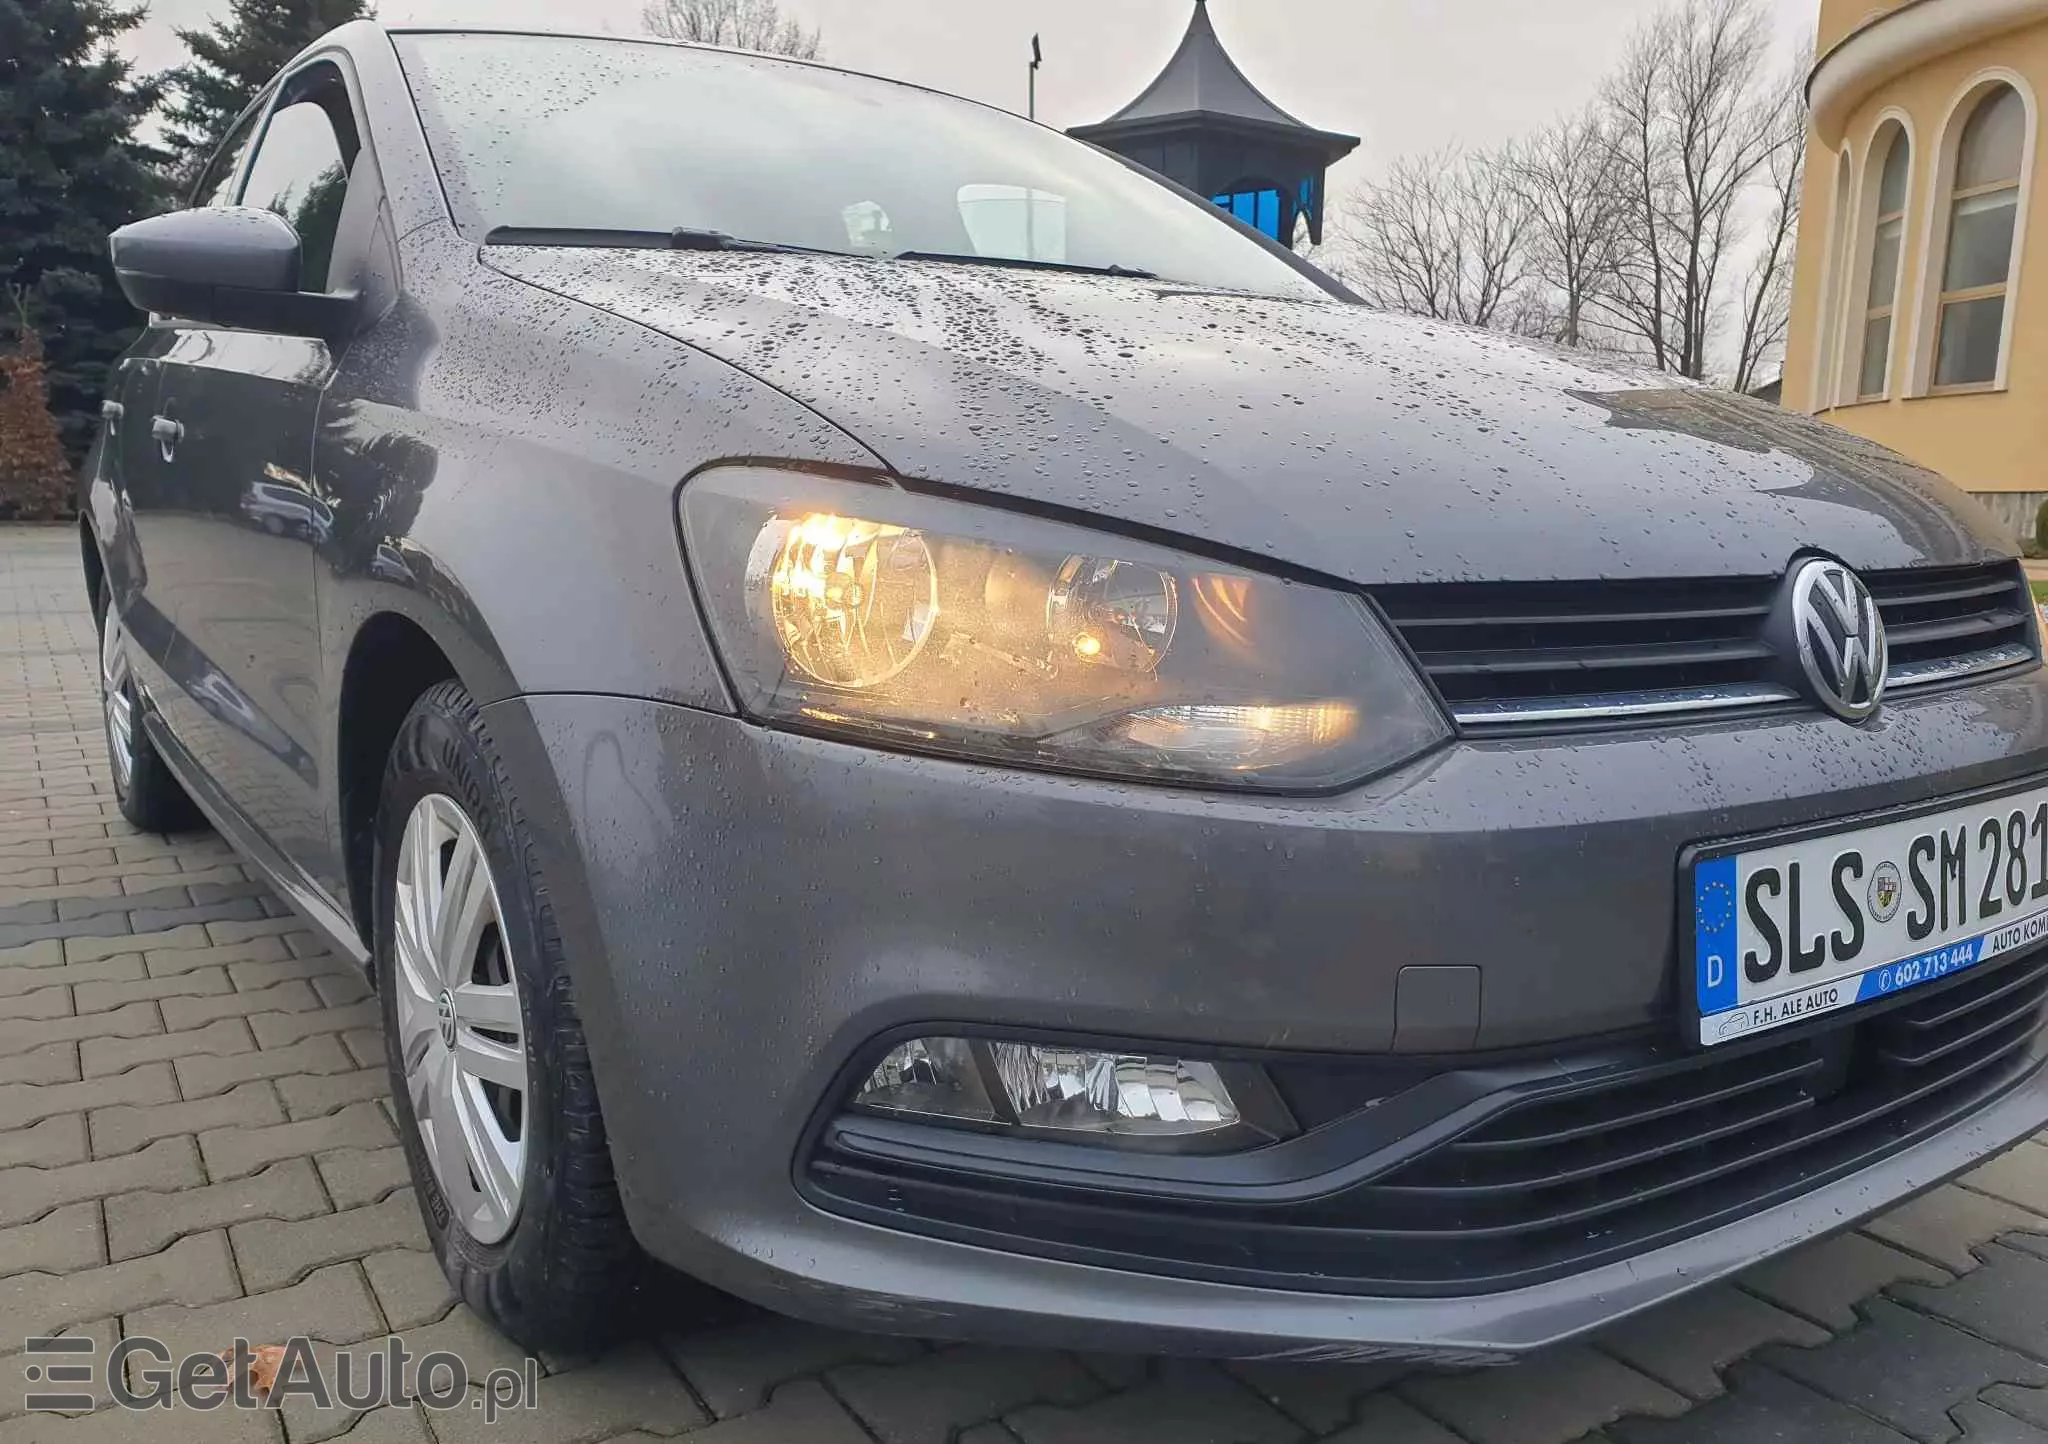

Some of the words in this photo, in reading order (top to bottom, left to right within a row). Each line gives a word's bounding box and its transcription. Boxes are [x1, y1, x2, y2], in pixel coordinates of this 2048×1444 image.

[1744, 851, 1865, 984] SLS
[1907, 825, 1966, 940] SM
[1979, 803, 2048, 919] 281
[1992, 926, 2021, 952] AUTO
[1707, 955, 1723, 988] D
[1895, 961, 1920, 986] 602
[1923, 952, 1947, 977] 713
[1951, 944, 1974, 966] 444
[1753, 1006, 1777, 1025] F.H.
[1781, 999, 1802, 1018] ALE
[1806, 988, 1838, 1010] AUTO
